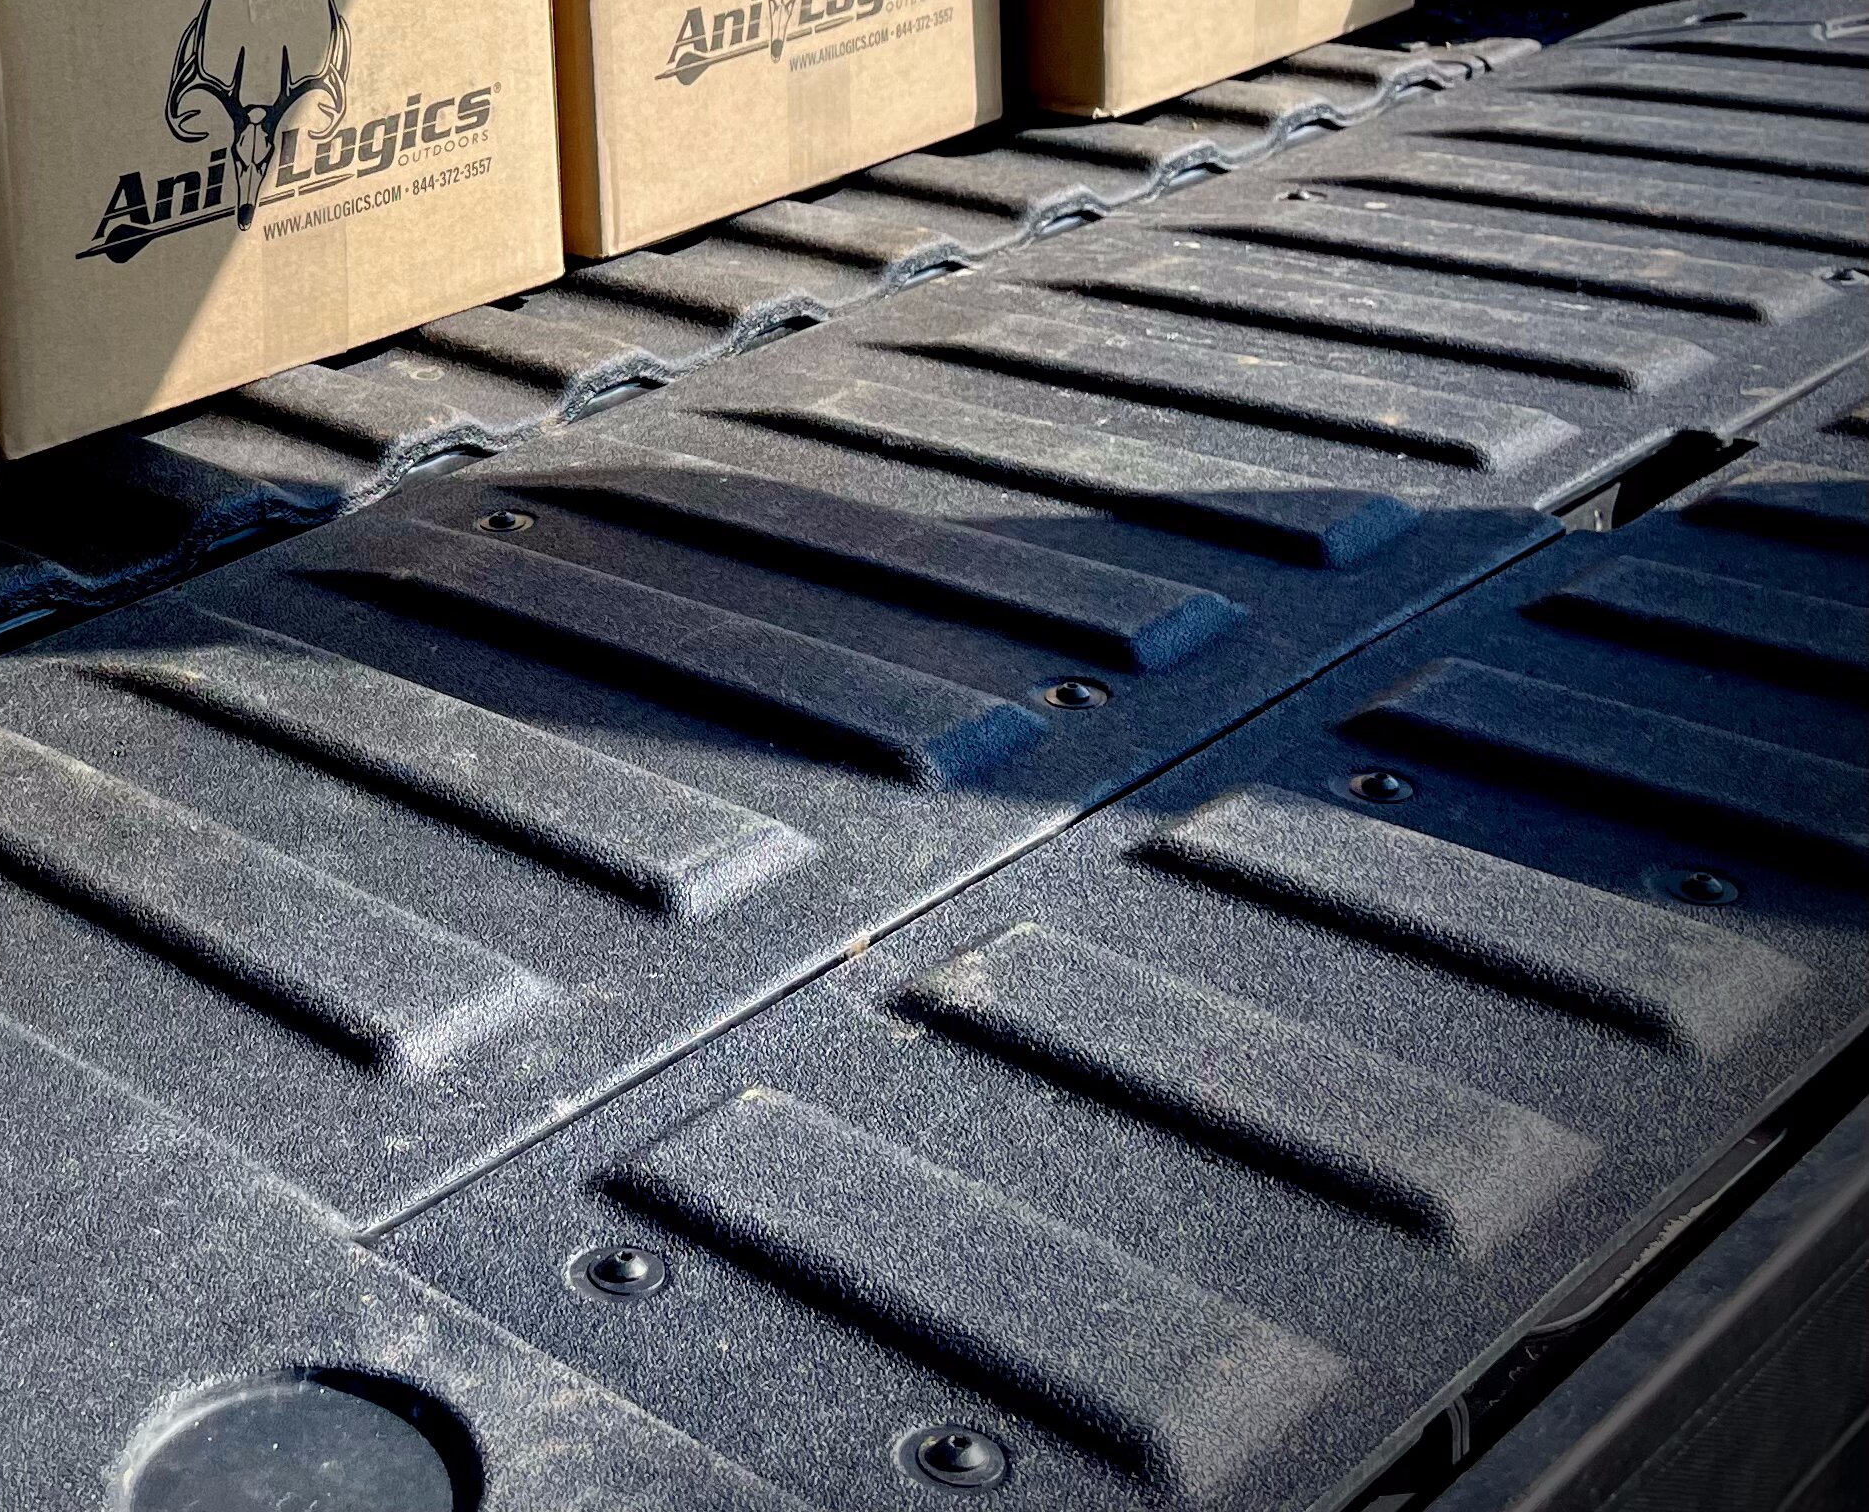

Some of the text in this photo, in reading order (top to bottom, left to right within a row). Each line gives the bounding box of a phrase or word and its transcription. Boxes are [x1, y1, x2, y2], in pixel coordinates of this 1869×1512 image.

[789, 6, 954, 73] WWW.ANILOGICS.COM 844-372-3557
[91, 85, 493, 242] Ani Logics
[396, 129, 490, 168] OUTDOORS
[262, 156, 493, 242] WWW.ANILOGICS.COM 844-372-3557
